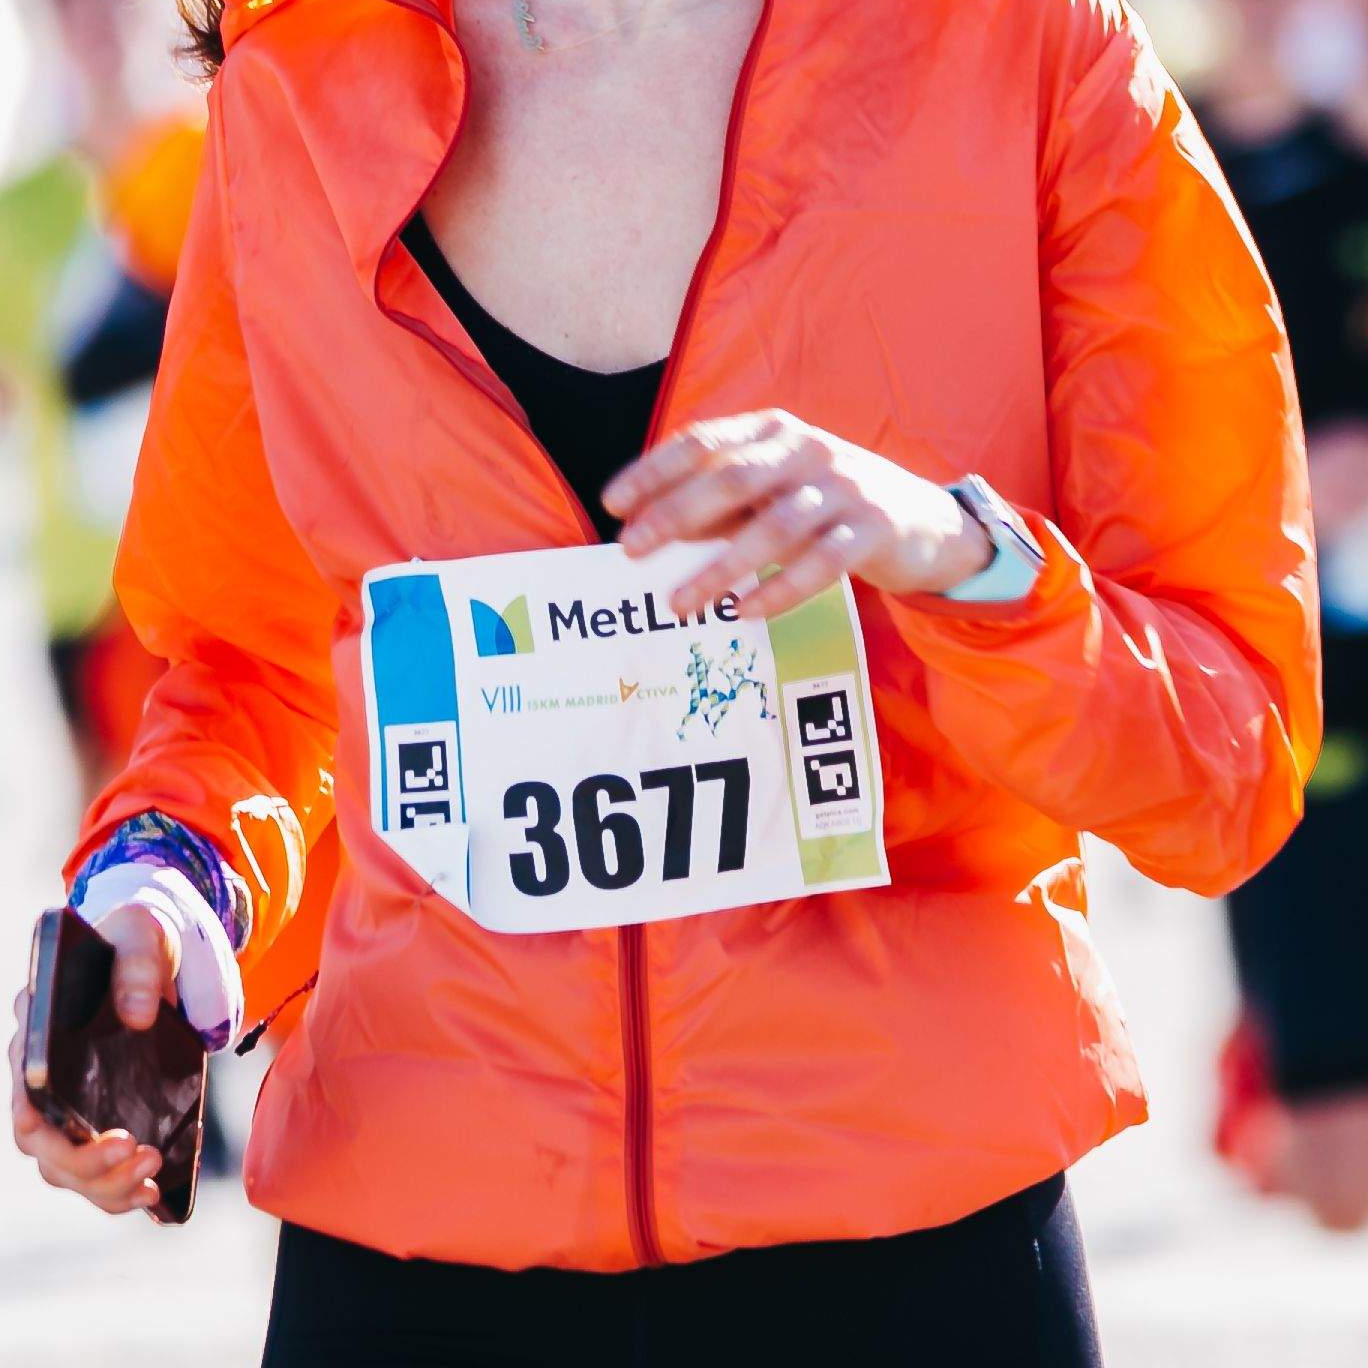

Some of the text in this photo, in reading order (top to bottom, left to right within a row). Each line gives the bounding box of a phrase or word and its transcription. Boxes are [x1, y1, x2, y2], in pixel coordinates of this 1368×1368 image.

[547, 590, 742, 641] MetLe
[481, 685, 521, 713] VIII
[564, 693, 618, 709] MADRID
[503, 757, 751, 897] 3677
